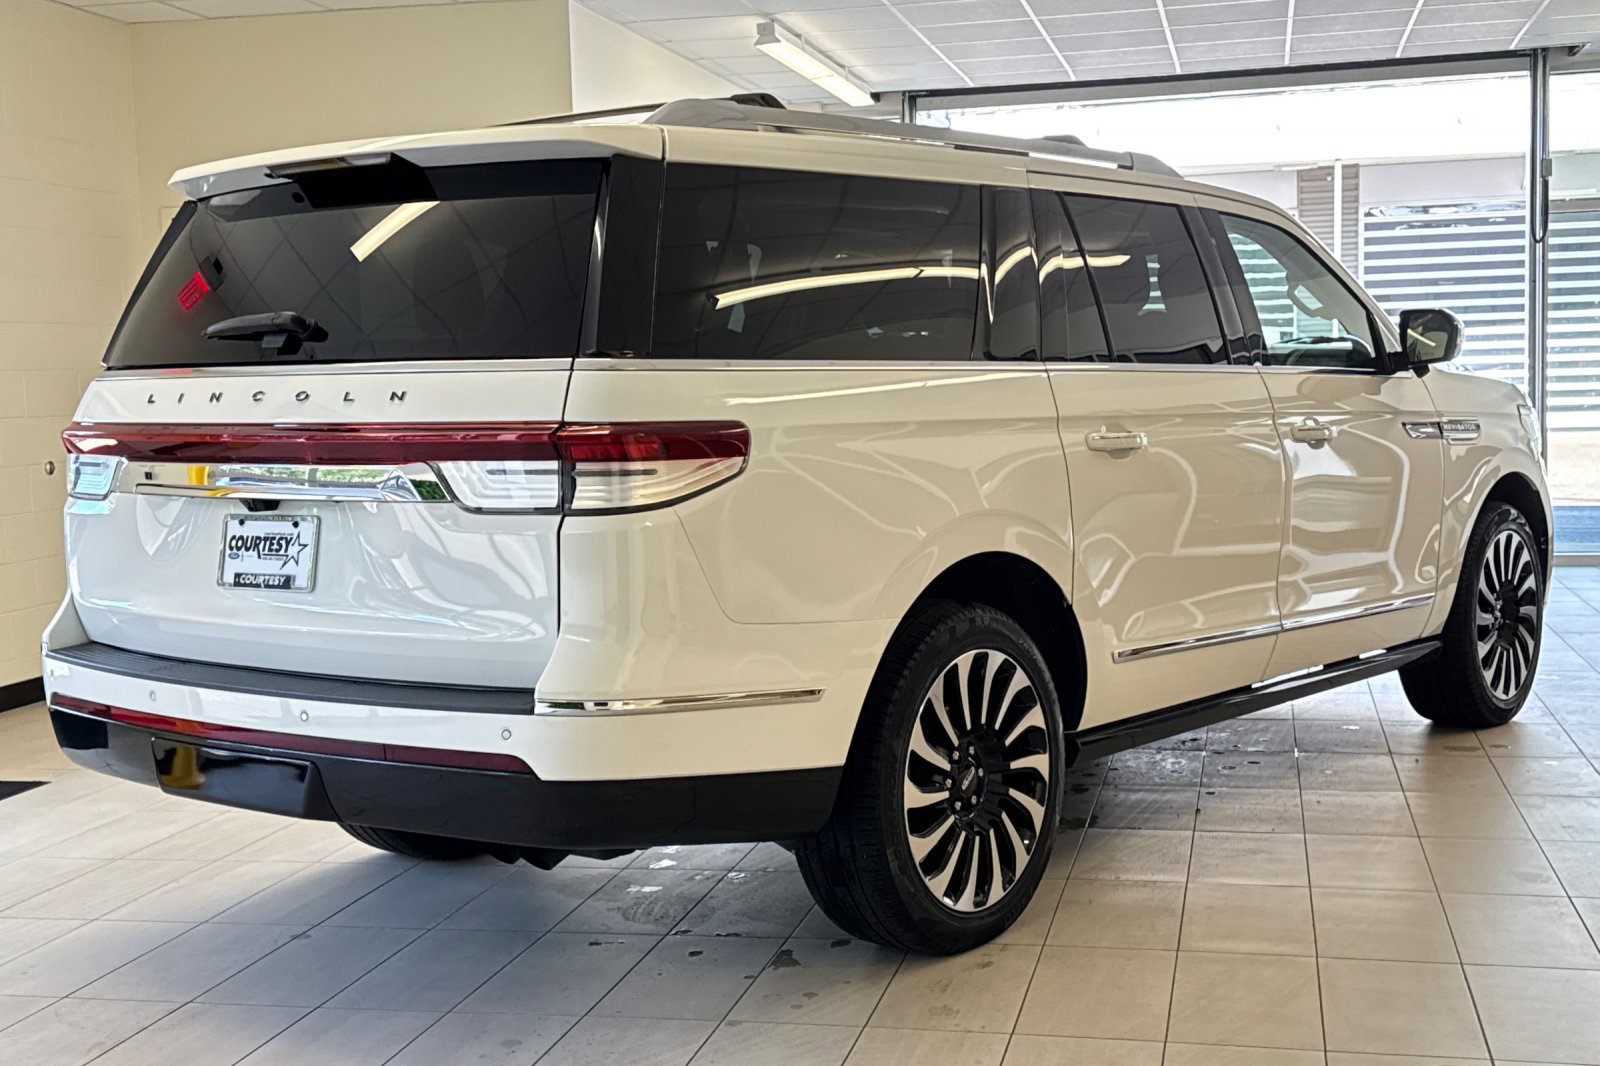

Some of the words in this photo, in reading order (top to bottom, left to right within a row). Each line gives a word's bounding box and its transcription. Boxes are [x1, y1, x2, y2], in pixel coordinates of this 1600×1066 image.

[147, 390, 407, 405] LINCOLN
[228, 535, 293, 559] COURTESY
[239, 575, 286, 588] COURTESY
